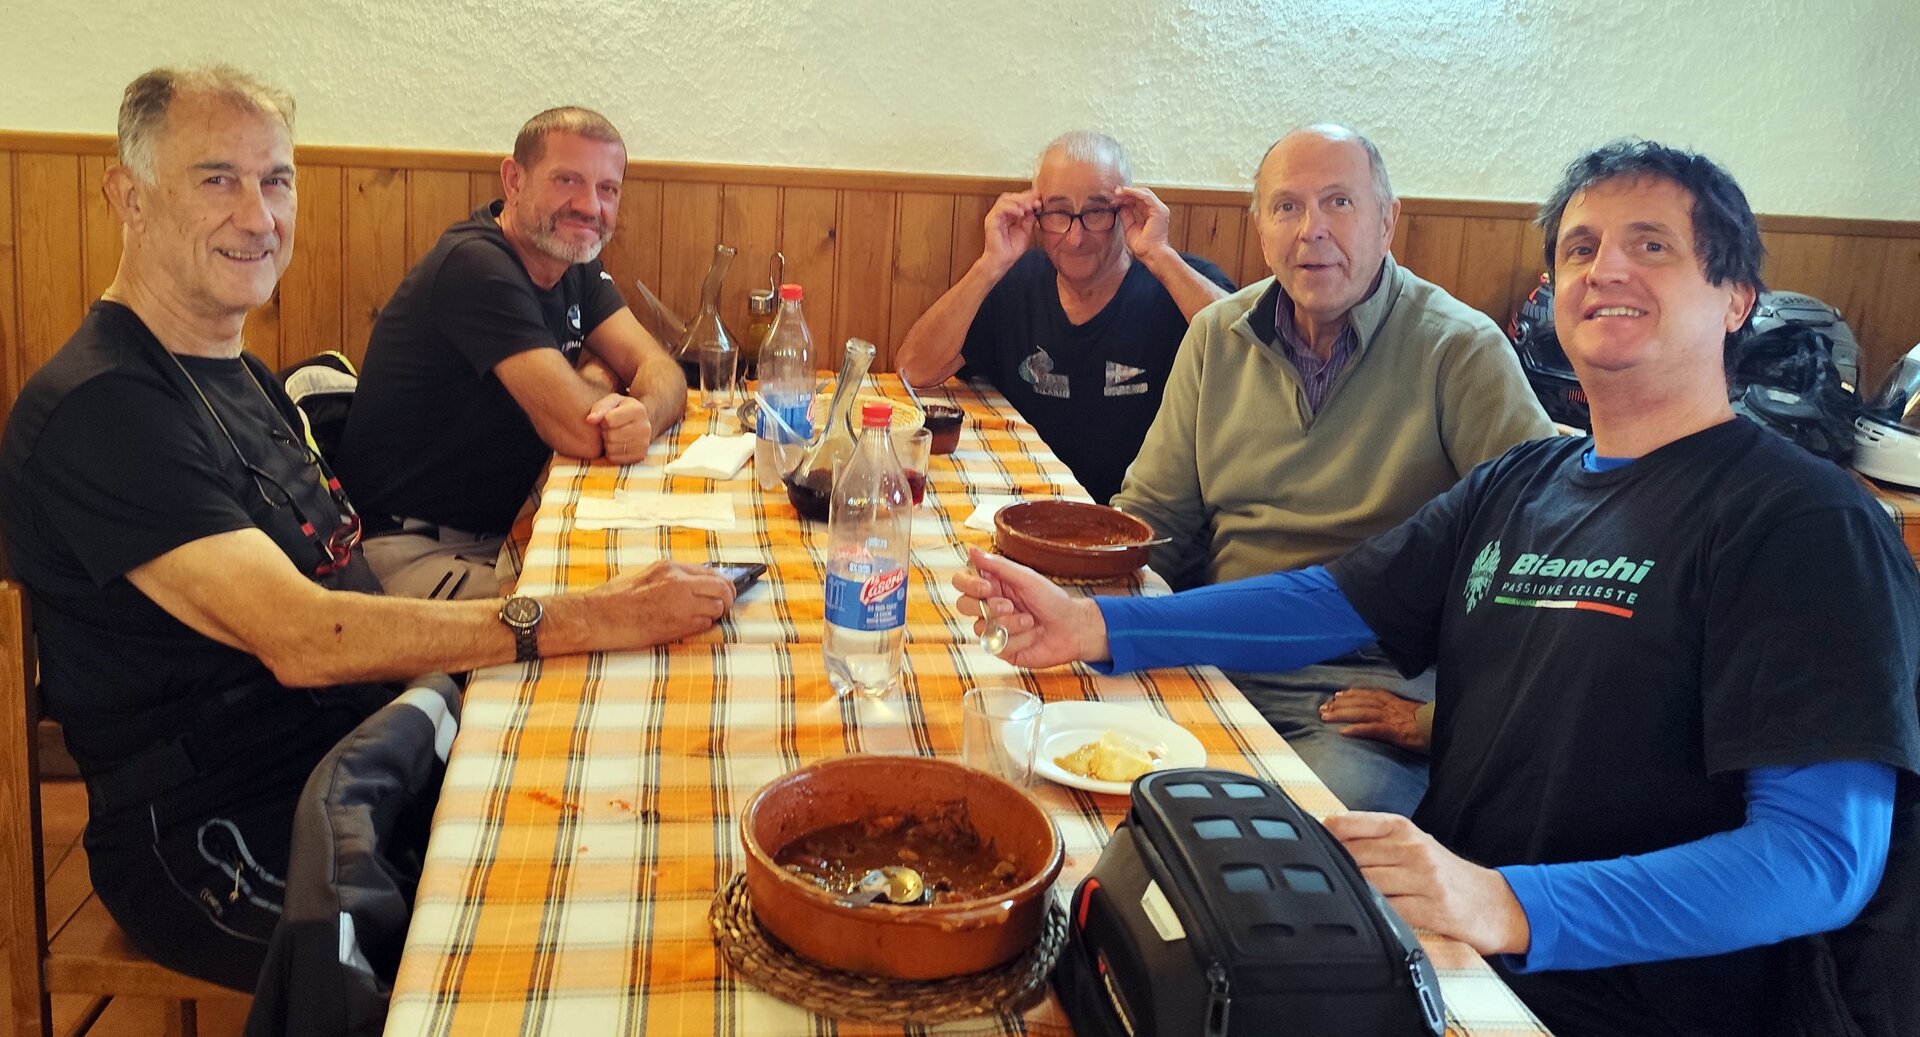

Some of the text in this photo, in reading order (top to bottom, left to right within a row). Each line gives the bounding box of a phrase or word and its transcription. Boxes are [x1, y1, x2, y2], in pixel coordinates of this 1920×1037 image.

[1508, 553, 1655, 584] Bianchi
[1501, 582, 1639, 604] PASSIONE CELESTE
